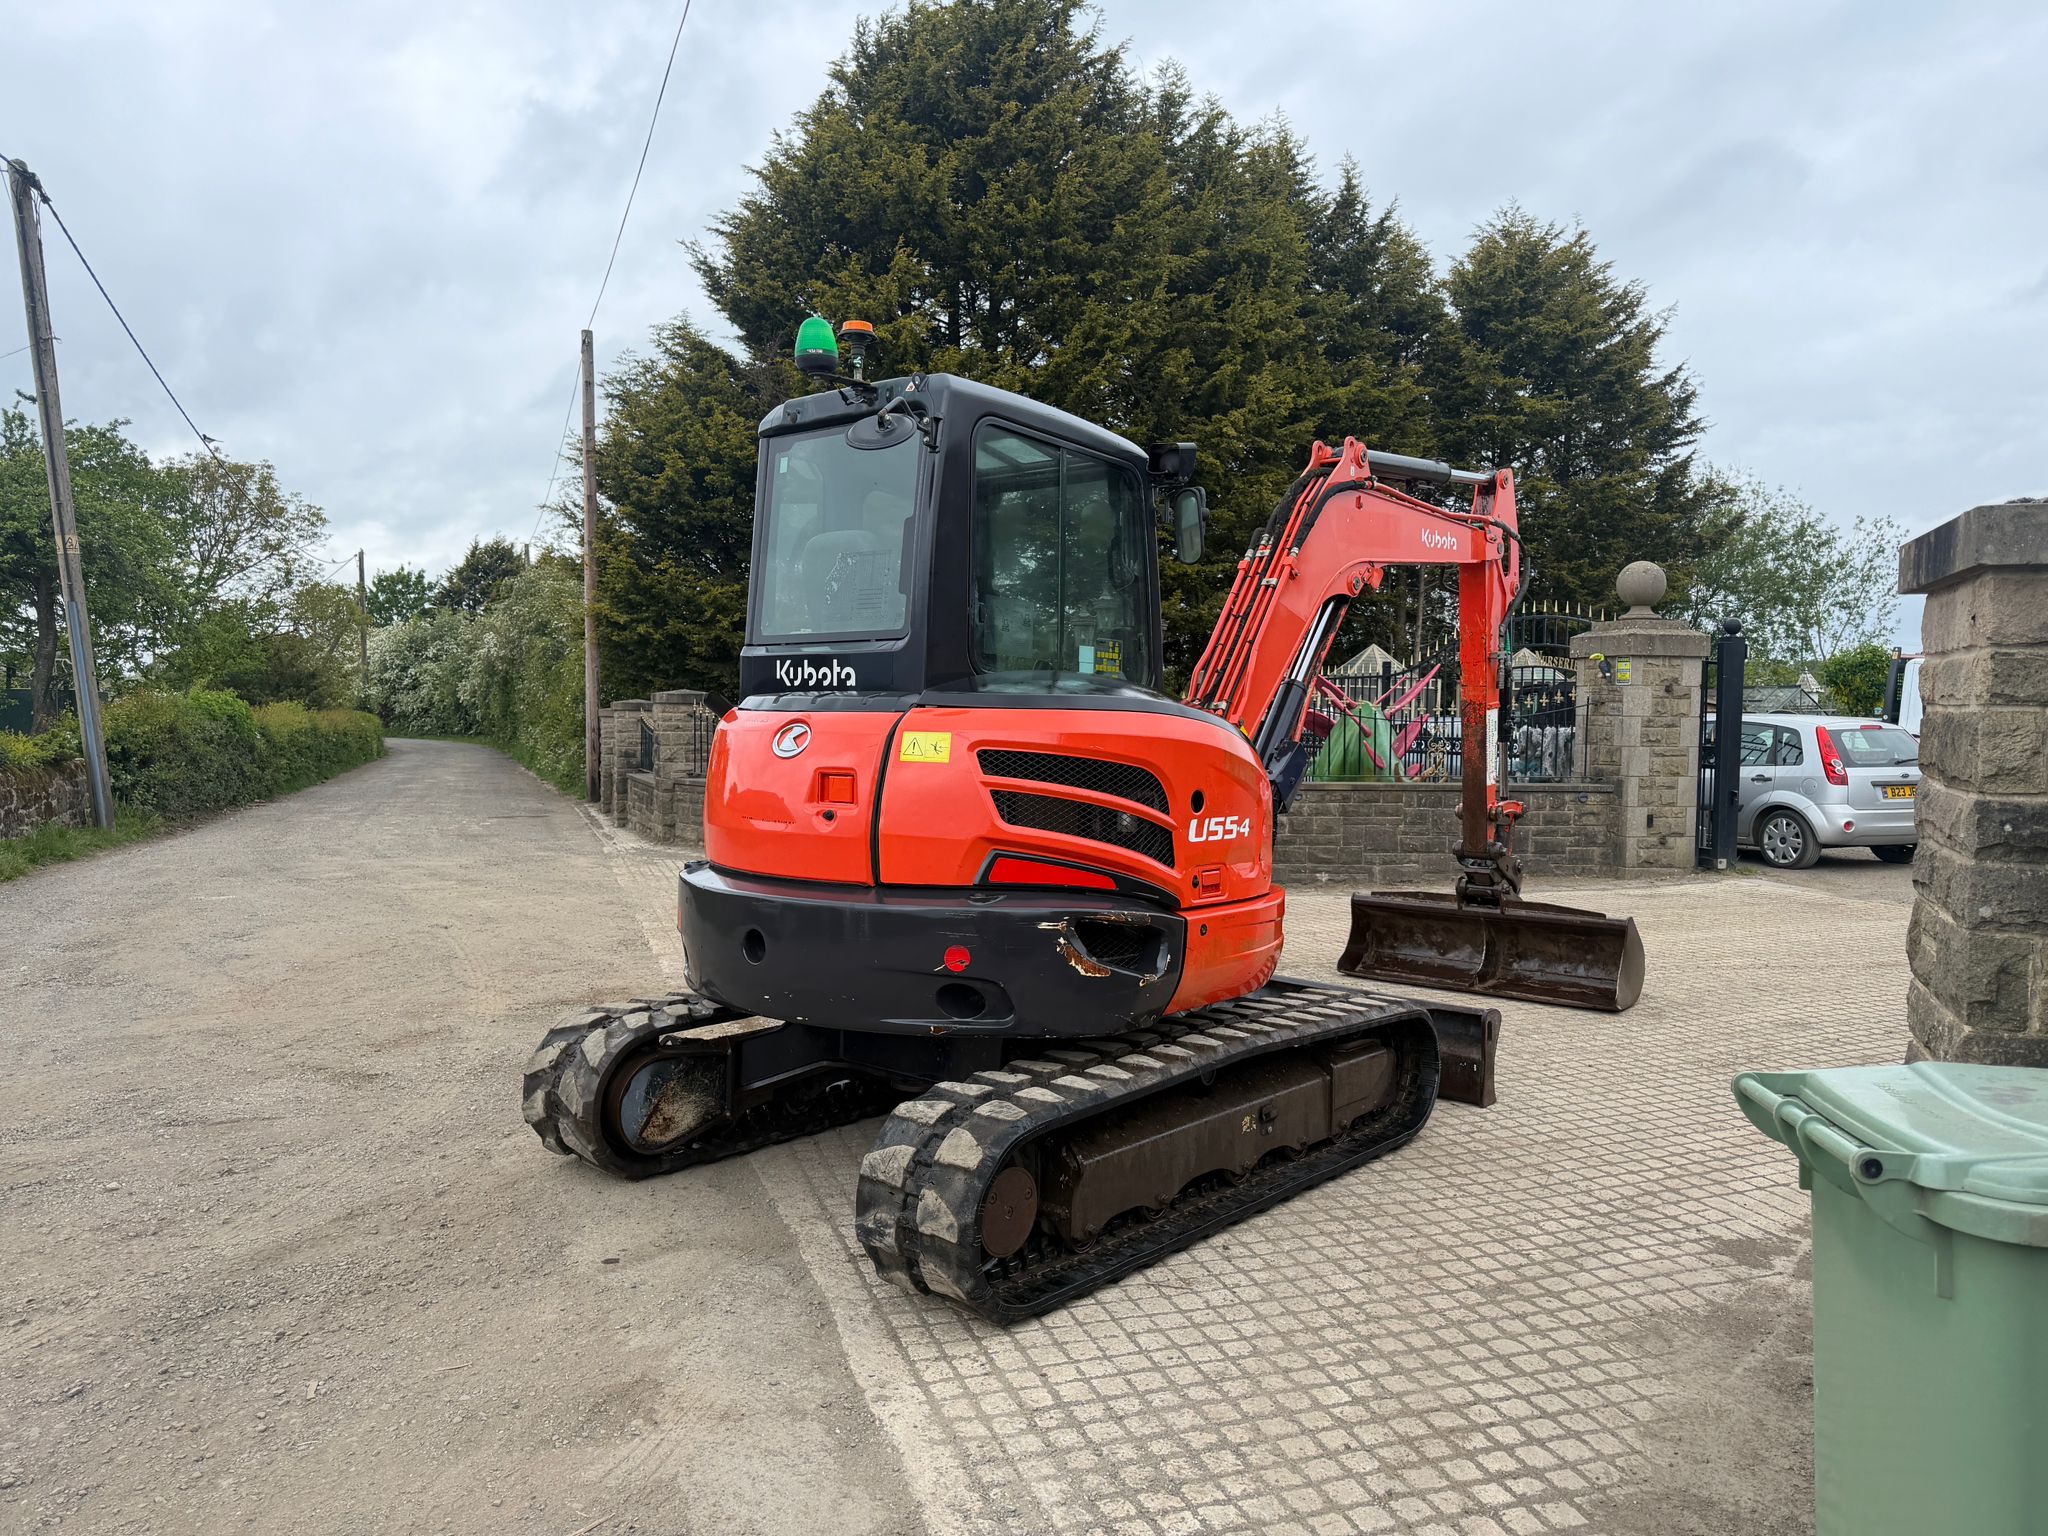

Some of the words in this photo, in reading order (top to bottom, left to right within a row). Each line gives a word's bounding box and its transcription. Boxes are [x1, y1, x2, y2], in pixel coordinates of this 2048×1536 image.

[1421, 527, 1458, 551] Kubota
[1534, 650, 1578, 671] NURSERIE
[776, 658, 856, 687] Kubota
[1890, 787, 1907, 797] B23
